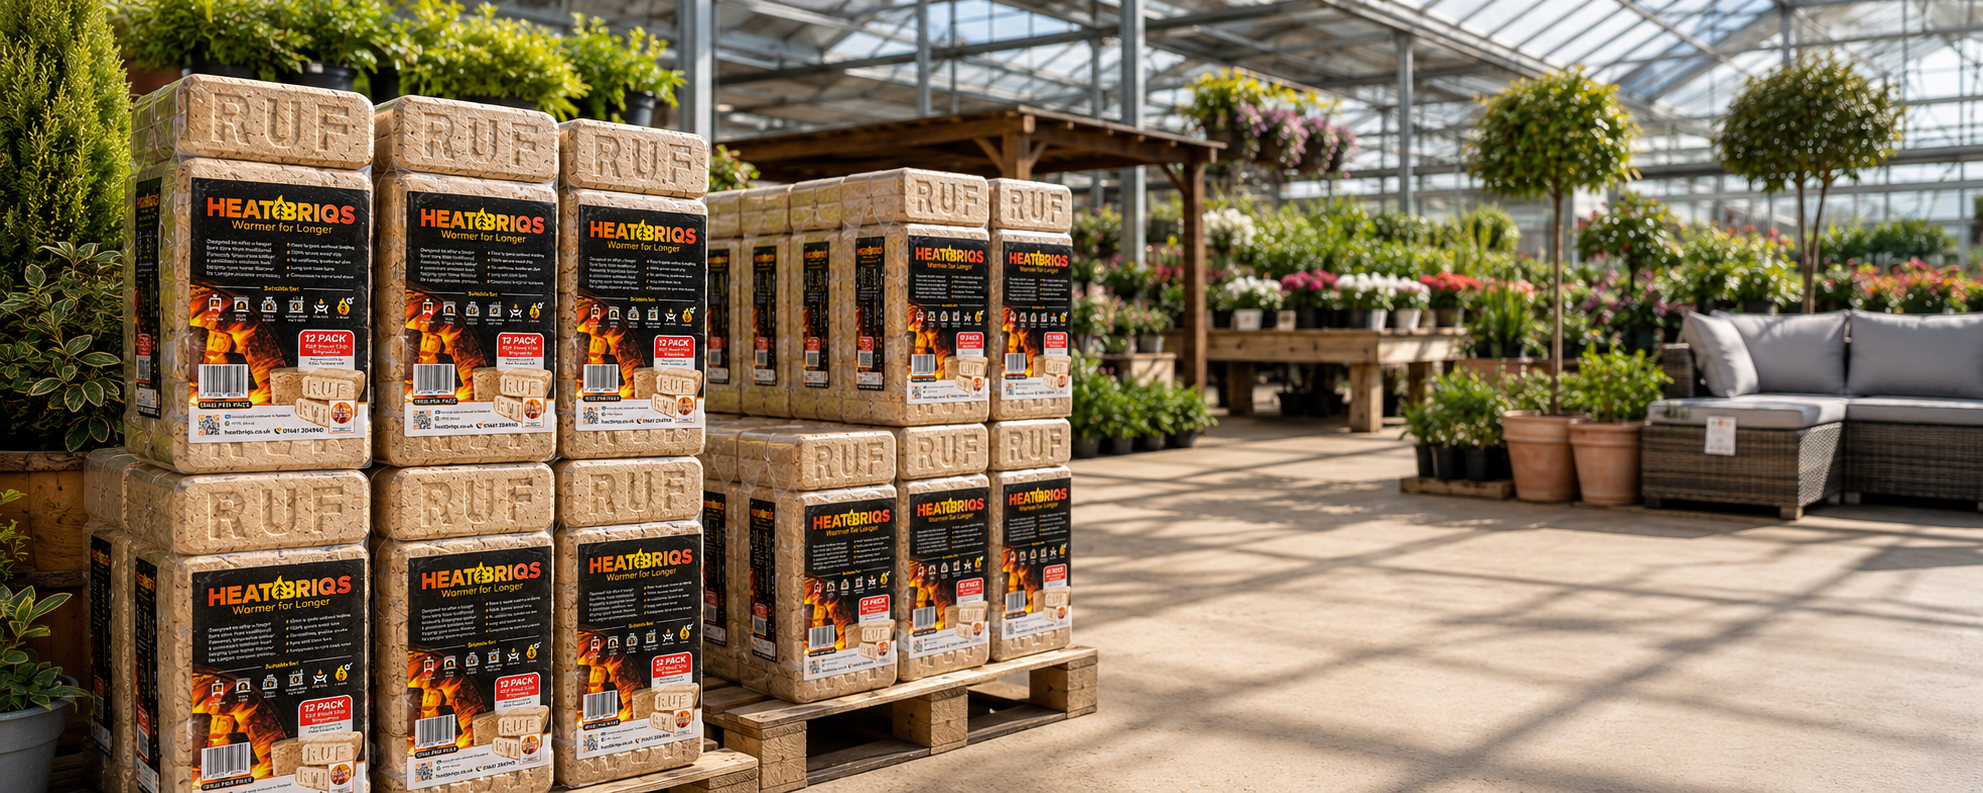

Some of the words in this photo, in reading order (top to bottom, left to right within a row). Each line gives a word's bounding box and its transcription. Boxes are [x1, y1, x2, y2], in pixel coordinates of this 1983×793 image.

[212, 93, 350, 152] RUF
[421, 112, 538, 166] RUF
[593, 135, 692, 185] RUF
[207, 195, 356, 224] HEATBRIQS
[916, 179, 980, 215] RUF
[1009, 189, 1063, 222] RUF
[279, 223, 294, 233] for
[296, 224, 333, 235] Longer
[420, 207, 545, 234] HEATBRIQS
[590, 219, 696, 244] HEATBRIQS
[480, 232, 493, 241] for
[495, 233, 527, 244] Longer
[641, 243, 652, 251] for
[653, 244, 680, 253] Longer
[305, 334, 316, 343] 12
[317, 334, 347, 343] PACK
[513, 337, 538, 345] PACK
[917, 435, 978, 470] RUF
[1009, 428, 1062, 460] RUF
[814, 442, 885, 480] RUF
[420, 478, 533, 530] RUF
[588, 469, 686, 516] RUF
[207, 486, 344, 541] RUF
[589, 548, 693, 574] HEATBRIQS
[639, 570, 650, 578] for
[651, 568, 677, 578] Longer
[421, 561, 541, 590] HEATBRIQS
[479, 585, 492, 594] for
[494, 582, 524, 593] Longer
[208, 575, 352, 607] HEATBRIQS
[278, 601, 293, 611] for
[296, 598, 331, 609] Longer
[665, 655, 686, 665] PACK
[510, 677, 535, 687] PACK
[304, 704, 315, 712] 12
[316, 699, 346, 711] PACK
